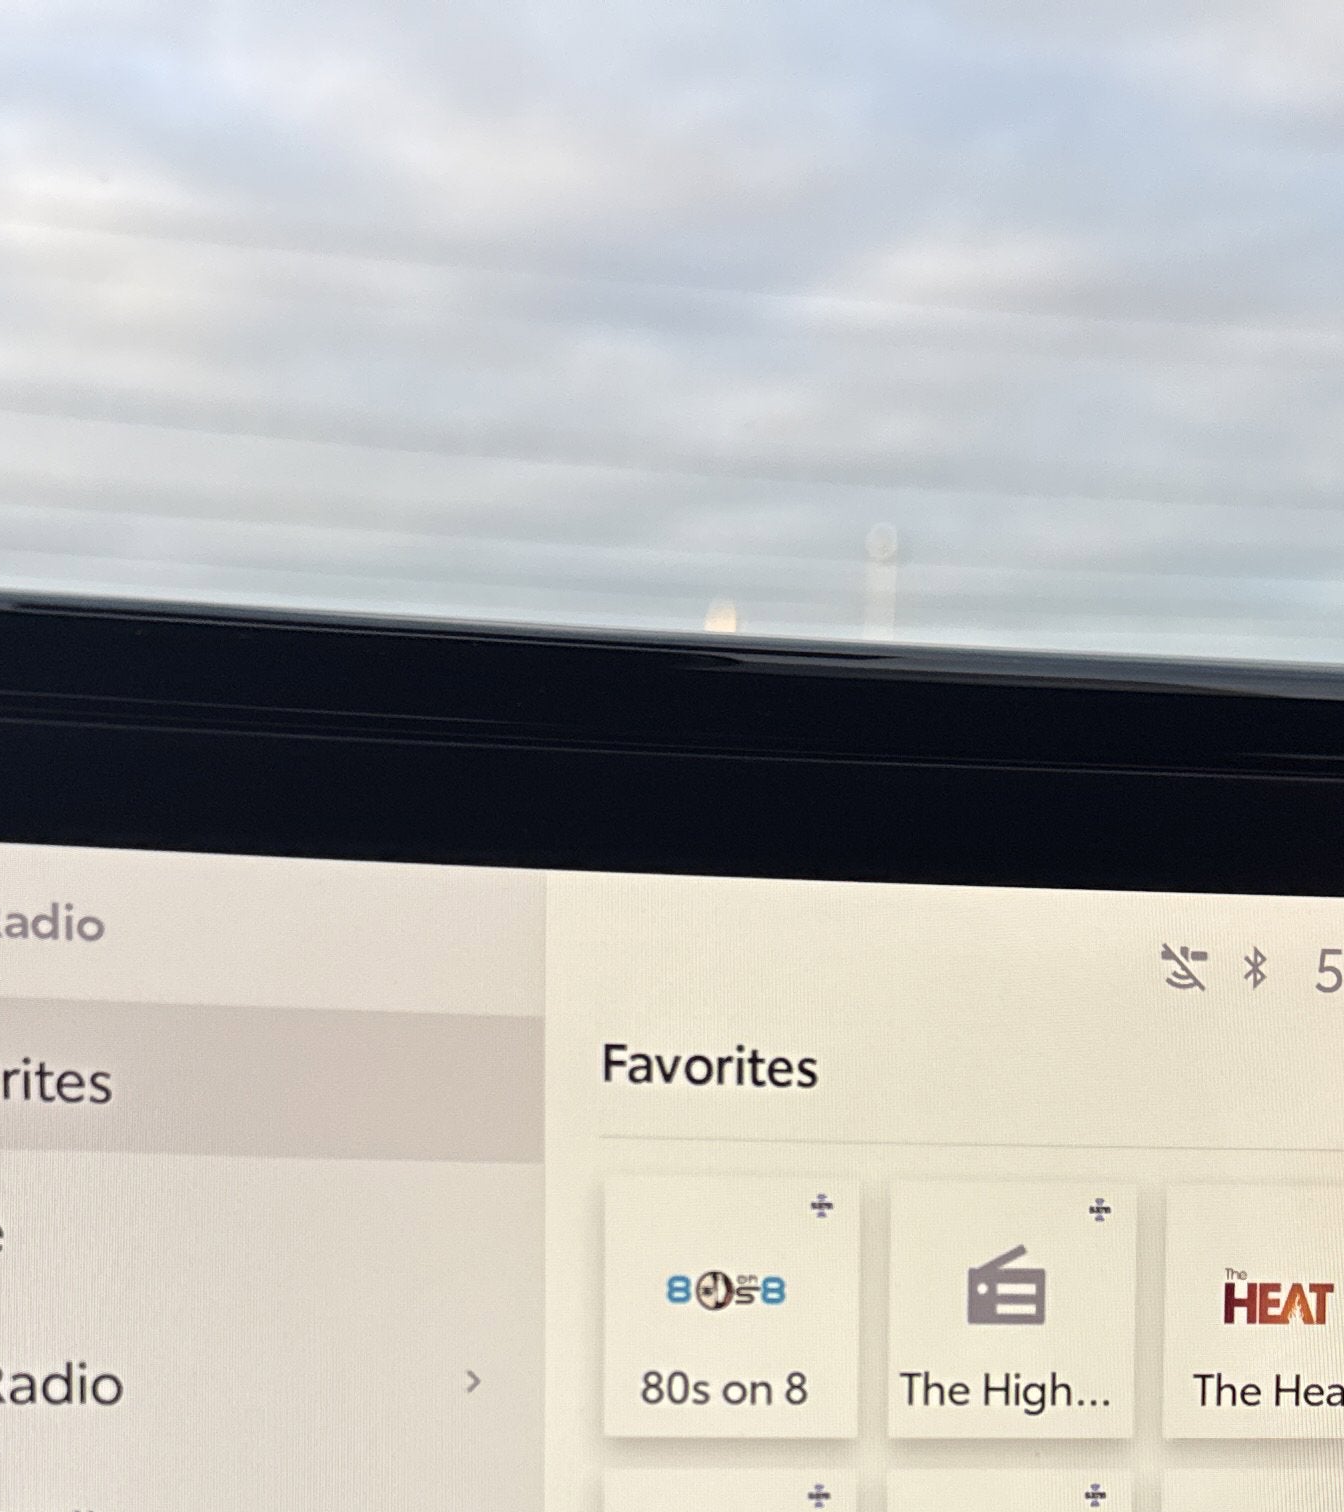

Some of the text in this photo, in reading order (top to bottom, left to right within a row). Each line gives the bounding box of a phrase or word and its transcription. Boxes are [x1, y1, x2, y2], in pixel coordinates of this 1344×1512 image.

[602, 1042, 819, 1090] Favorites
[1224, 1267, 1248, 1281] The
[1223, 1282, 1335, 1325] HEAT
[640, 1370, 809, 1407] 80s on 8
[899, 1370, 1111, 1418] The High...
[1192, 1371, 1262, 1408] The
